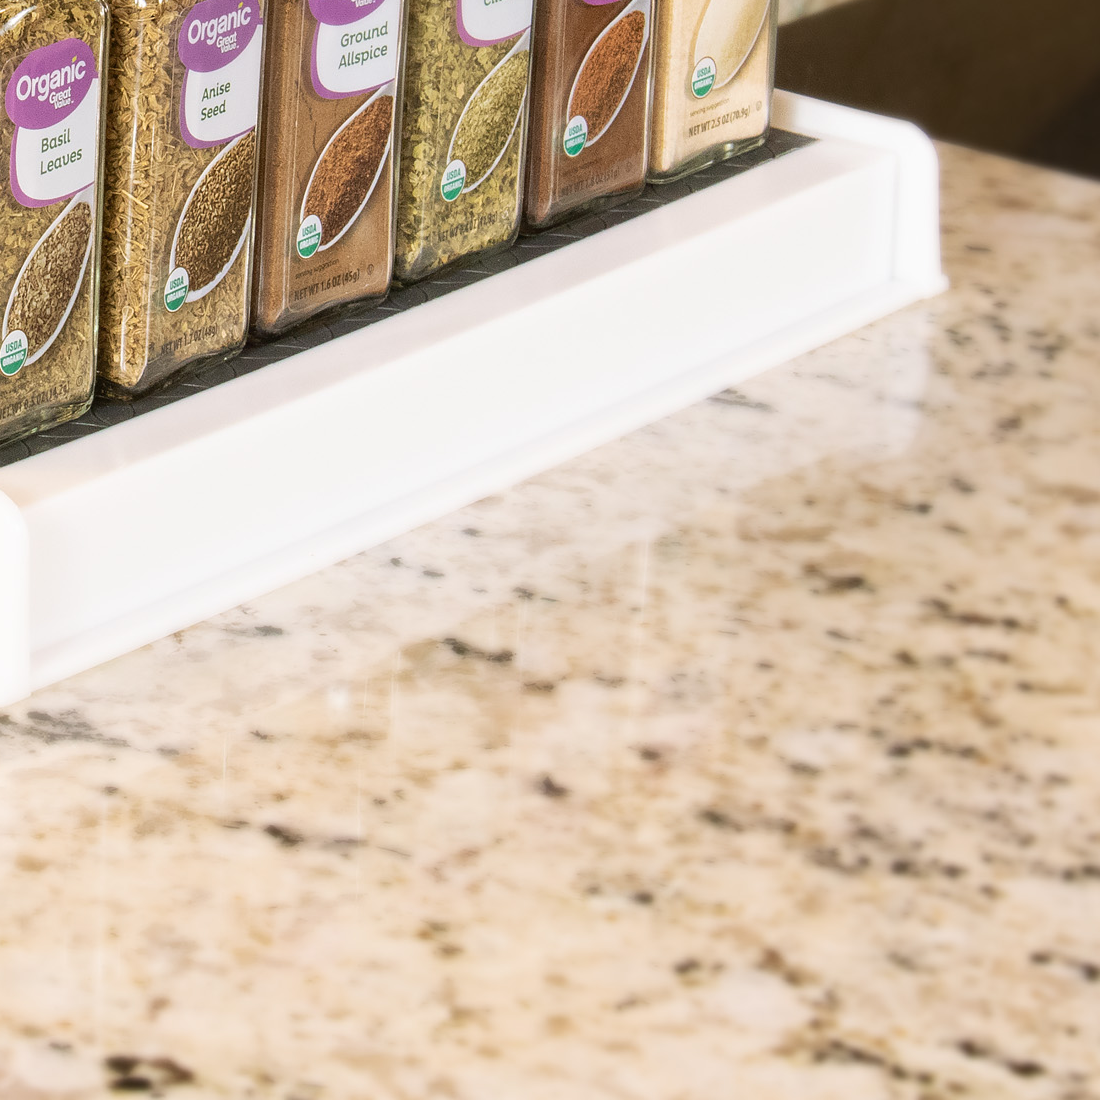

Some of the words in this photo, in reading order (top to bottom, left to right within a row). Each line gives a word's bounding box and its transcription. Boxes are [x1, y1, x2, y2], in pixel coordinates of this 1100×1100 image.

[188, 2, 251, 45] Organic
[216, 32, 237, 48] Great
[341, 21, 388, 47] Ground
[221, 43, 236, 53] Value
[338, 45, 387, 70] Allspice
[16, 55, 86, 101] Organic
[697, 66, 711, 78] USDA
[50, 86, 71, 104] Great
[202, 82, 231, 102] Anise
[54, 97, 71, 109] Value
[201, 100, 226, 121] Seed
[569, 124, 582, 136] USDA
[689, 125, 700, 137] NET
[701, 121, 710, 132] WT
[711, 118, 721, 129] 2.5
[722, 114, 730, 124] OZ
[42, 128, 70, 153] Basil
[41, 148, 82, 175] Leaves
[447, 168, 461, 180] USDA
[302, 224, 316, 237] USDA
[170, 276, 184, 290] USDA
[294, 288, 307, 301] NET
[308, 283, 319, 295] WT
[321, 279, 331, 291] 1.6
[333, 275, 341, 287] OZ
[342, 269, 360, 286] (45g)
[6, 339, 22, 353] USDA
